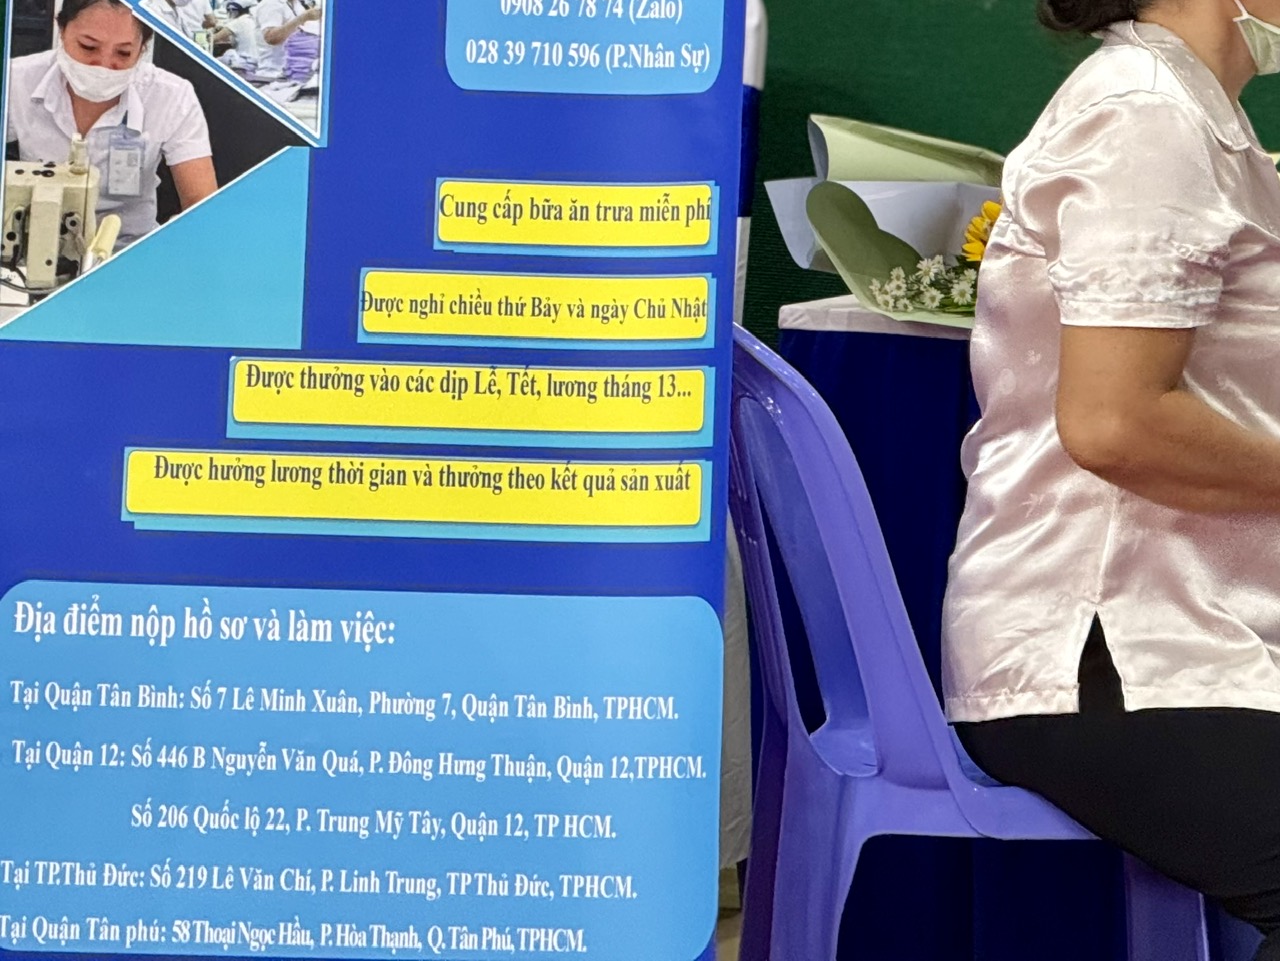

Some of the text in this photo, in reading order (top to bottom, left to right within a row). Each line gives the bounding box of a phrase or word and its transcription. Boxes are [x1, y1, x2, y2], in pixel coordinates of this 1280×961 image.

[466, 39, 498, 64] 028
[504, 41, 525, 64] 39
[531, 42, 562, 66] 710
[568, 43, 600, 67] 596
[681, 43, 710, 73] Sự)
[440, 190, 712, 228] Cung cấp bữa ăn trưa miễn phí
[361, 288, 707, 324] Được nghỉ chiều thứ Bảy và ngày Chủ Nhật
[246, 364, 294, 395] Được
[300, 366, 364, 397] thưởng
[370, 368, 400, 392] vào
[406, 369, 434, 392] các
[440, 370, 468, 401] dịp
[474, 366, 502, 398] Lễ,
[507, 365, 542, 400] Tết,
[547, 373, 598, 403] lương
[604, 374, 651, 404] tháng
[154, 455, 690, 497] Được hưởng lương thời gian và thưởng theo kết quả sản xuất
[14, 595, 395, 652] Địa điểm nộp hồ sơ và làm việc:
[10, 680, 678, 723] Tại Quận Tân Bình: Số Lê Minh Xuân, Phường Quận Tân Bình, TPHCM.
[12, 738, 603, 784] Tại Quận 12: Số 446 Nguyễn Văn Quá, Đông Hưng Thuận, Quận
[131, 798, 528, 841] Số 206 Quốc lộ 22, Trung Mỹ Tây, Quận 12,
